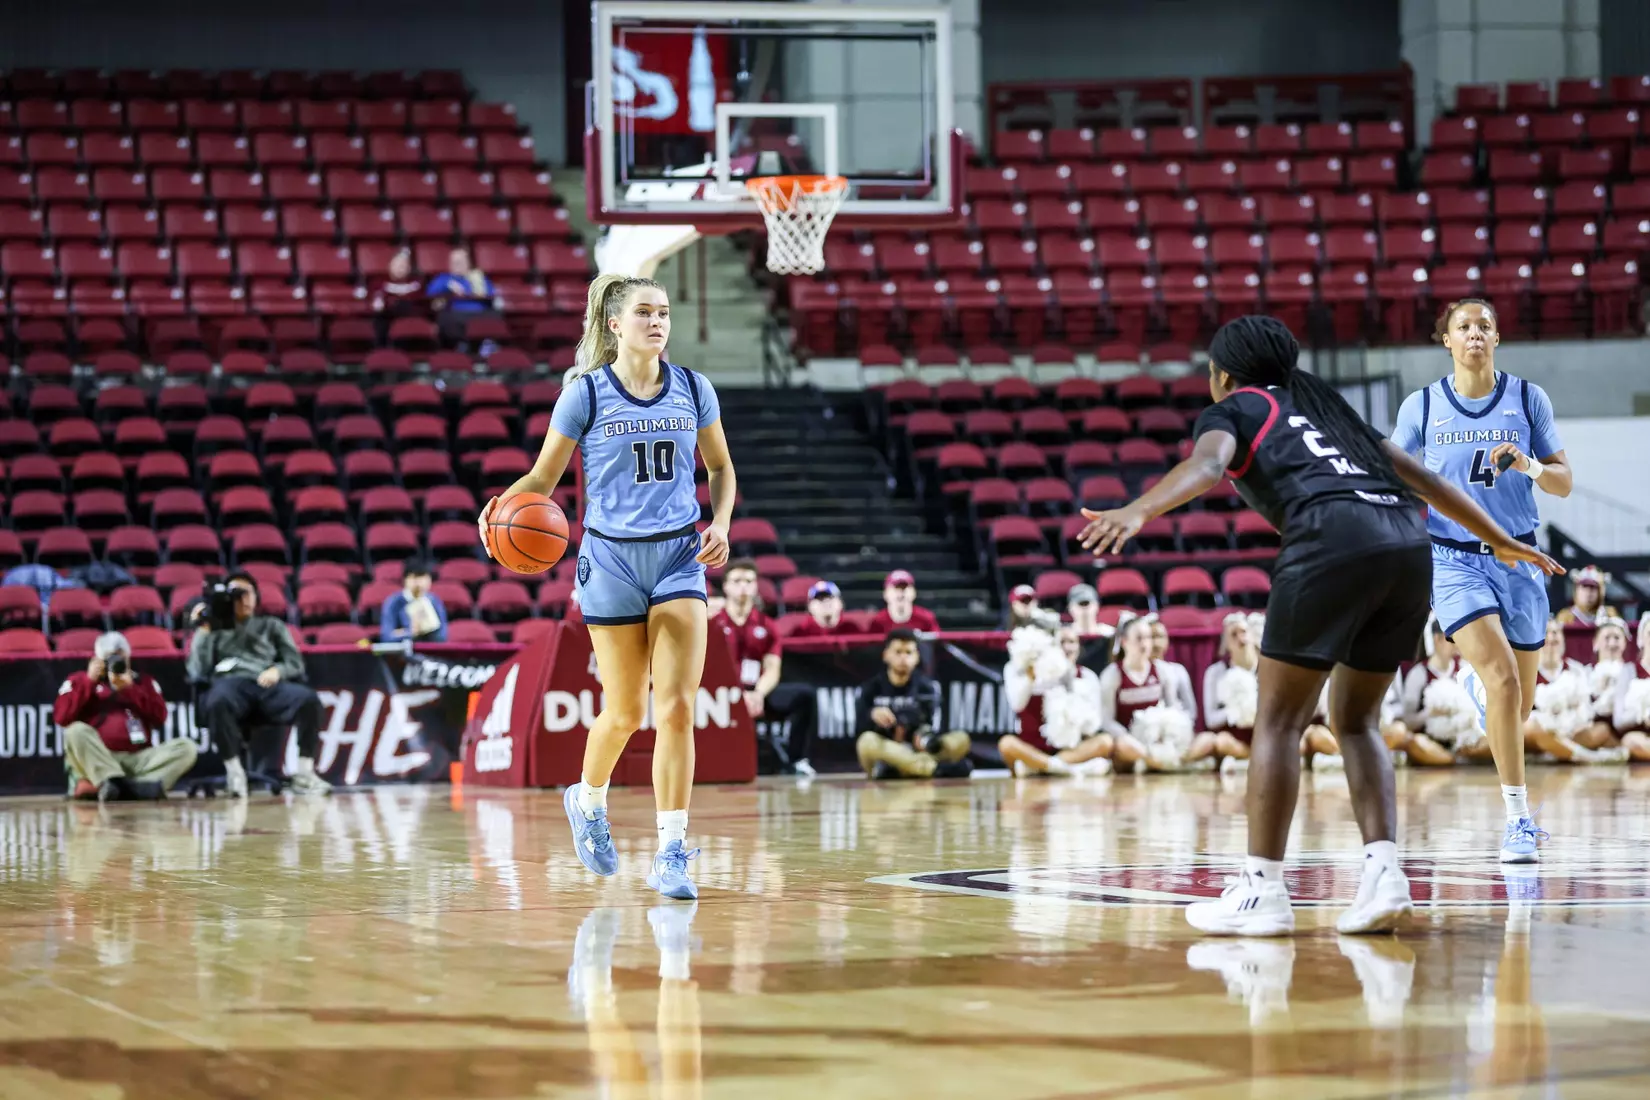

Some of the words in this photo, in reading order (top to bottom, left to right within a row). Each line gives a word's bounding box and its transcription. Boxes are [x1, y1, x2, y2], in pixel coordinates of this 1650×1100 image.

[604, 417, 695, 437] COLUMBIA
[1435, 429, 1520, 445] COLUMBIA
[632, 440, 676, 484] 10
[1468, 448, 1496, 489] 4
[544, 686, 741, 732] DUN'
